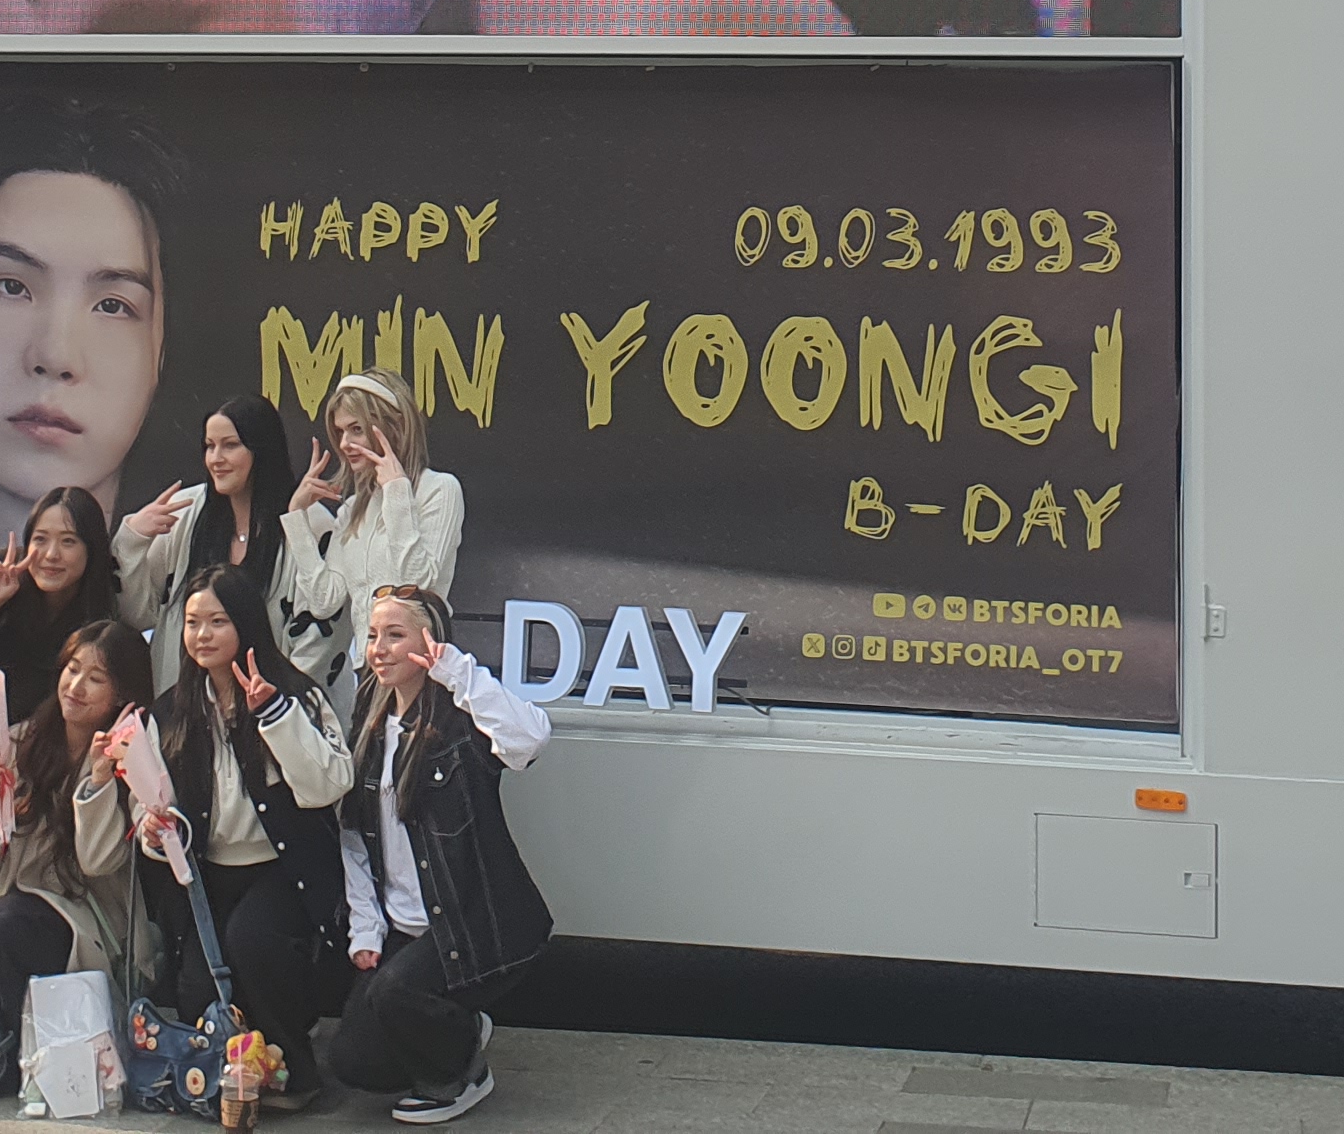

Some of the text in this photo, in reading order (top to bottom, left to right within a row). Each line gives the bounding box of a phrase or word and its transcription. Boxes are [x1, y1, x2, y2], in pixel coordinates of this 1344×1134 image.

[260, 198, 1122, 274] HAPPY 09.03.1993
[260, 294, 1124, 451] MIN YOONGI
[973, 599, 1123, 629] BTSFORIA
[892, 639, 1124, 676] BTSFORIA_OT7
